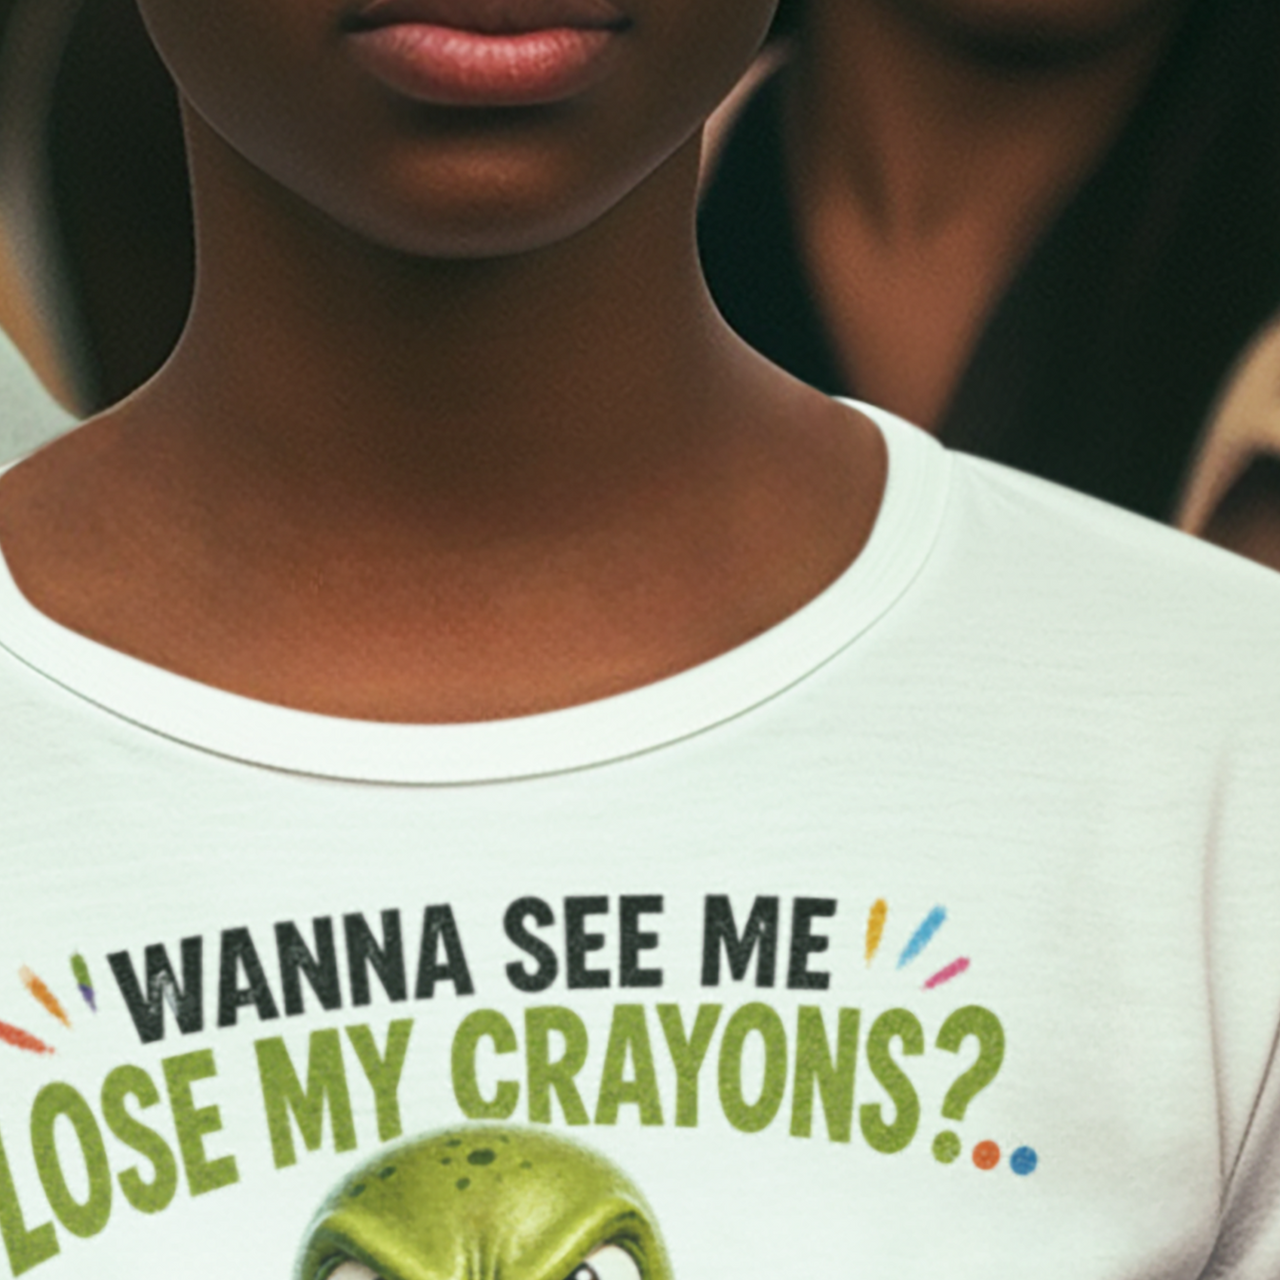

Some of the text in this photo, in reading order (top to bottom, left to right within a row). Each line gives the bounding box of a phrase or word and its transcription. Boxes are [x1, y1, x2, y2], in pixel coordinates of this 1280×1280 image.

[106, 894, 838, 1045] WANNA SEE ME
[254, 1017, 414, 1170] MY
